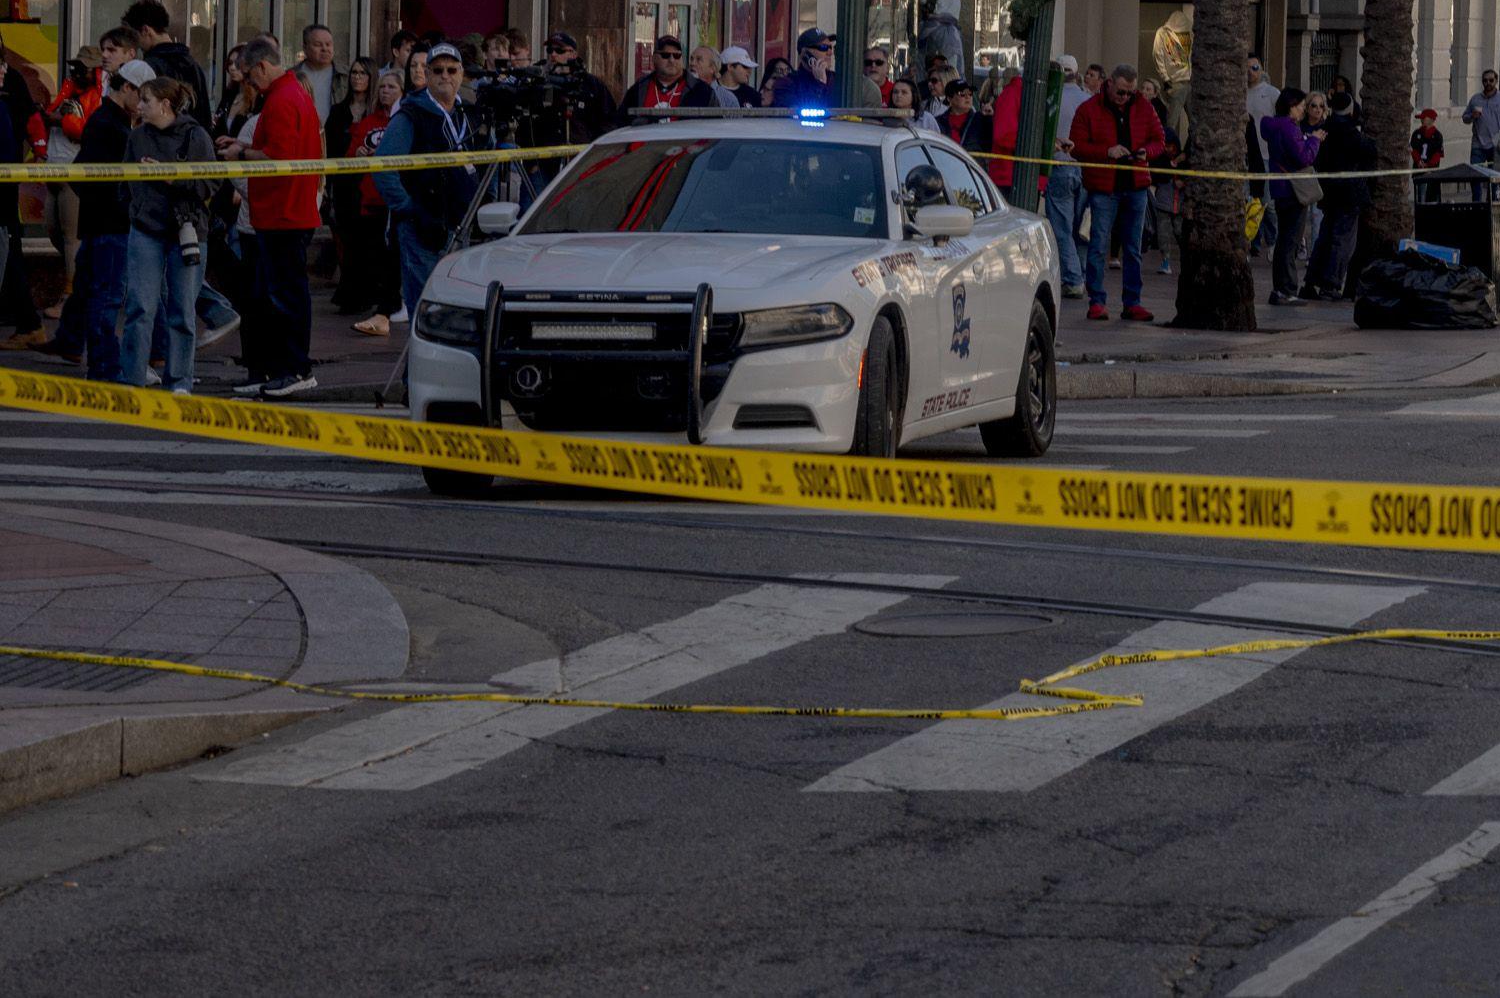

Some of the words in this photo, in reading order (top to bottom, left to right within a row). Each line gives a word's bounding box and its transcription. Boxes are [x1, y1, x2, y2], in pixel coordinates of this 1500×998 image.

[1421, 143, 1428, 160] 1
[921, 393, 945, 418] STATE
[946, 388, 972, 411] POLICE
[562, 442, 605, 474] CROSS
[604, 448, 637, 479] NOT
[636, 452, 656, 481] DO
[656, 453, 697, 486] SCENE
[698, 457, 743, 490] CRIME
[793, 461, 841, 499] CROSS
[843, 466, 874, 502] NOT
[875, 469, 896, 503] DO
[898, 470, 946, 508] SCENE
[947, 472, 996, 511] CRIME
[1058, 478, 1111, 519] CROSS
[1116, 481, 1148, 521] NOT
[1152, 483, 1174, 522] DO
[1181, 485, 1233, 526] SCENE
[1239, 488, 1294, 529] CRIME
[1370, 493, 1431, 536] CROSS
[1437, 496, 1474, 538] NOT
